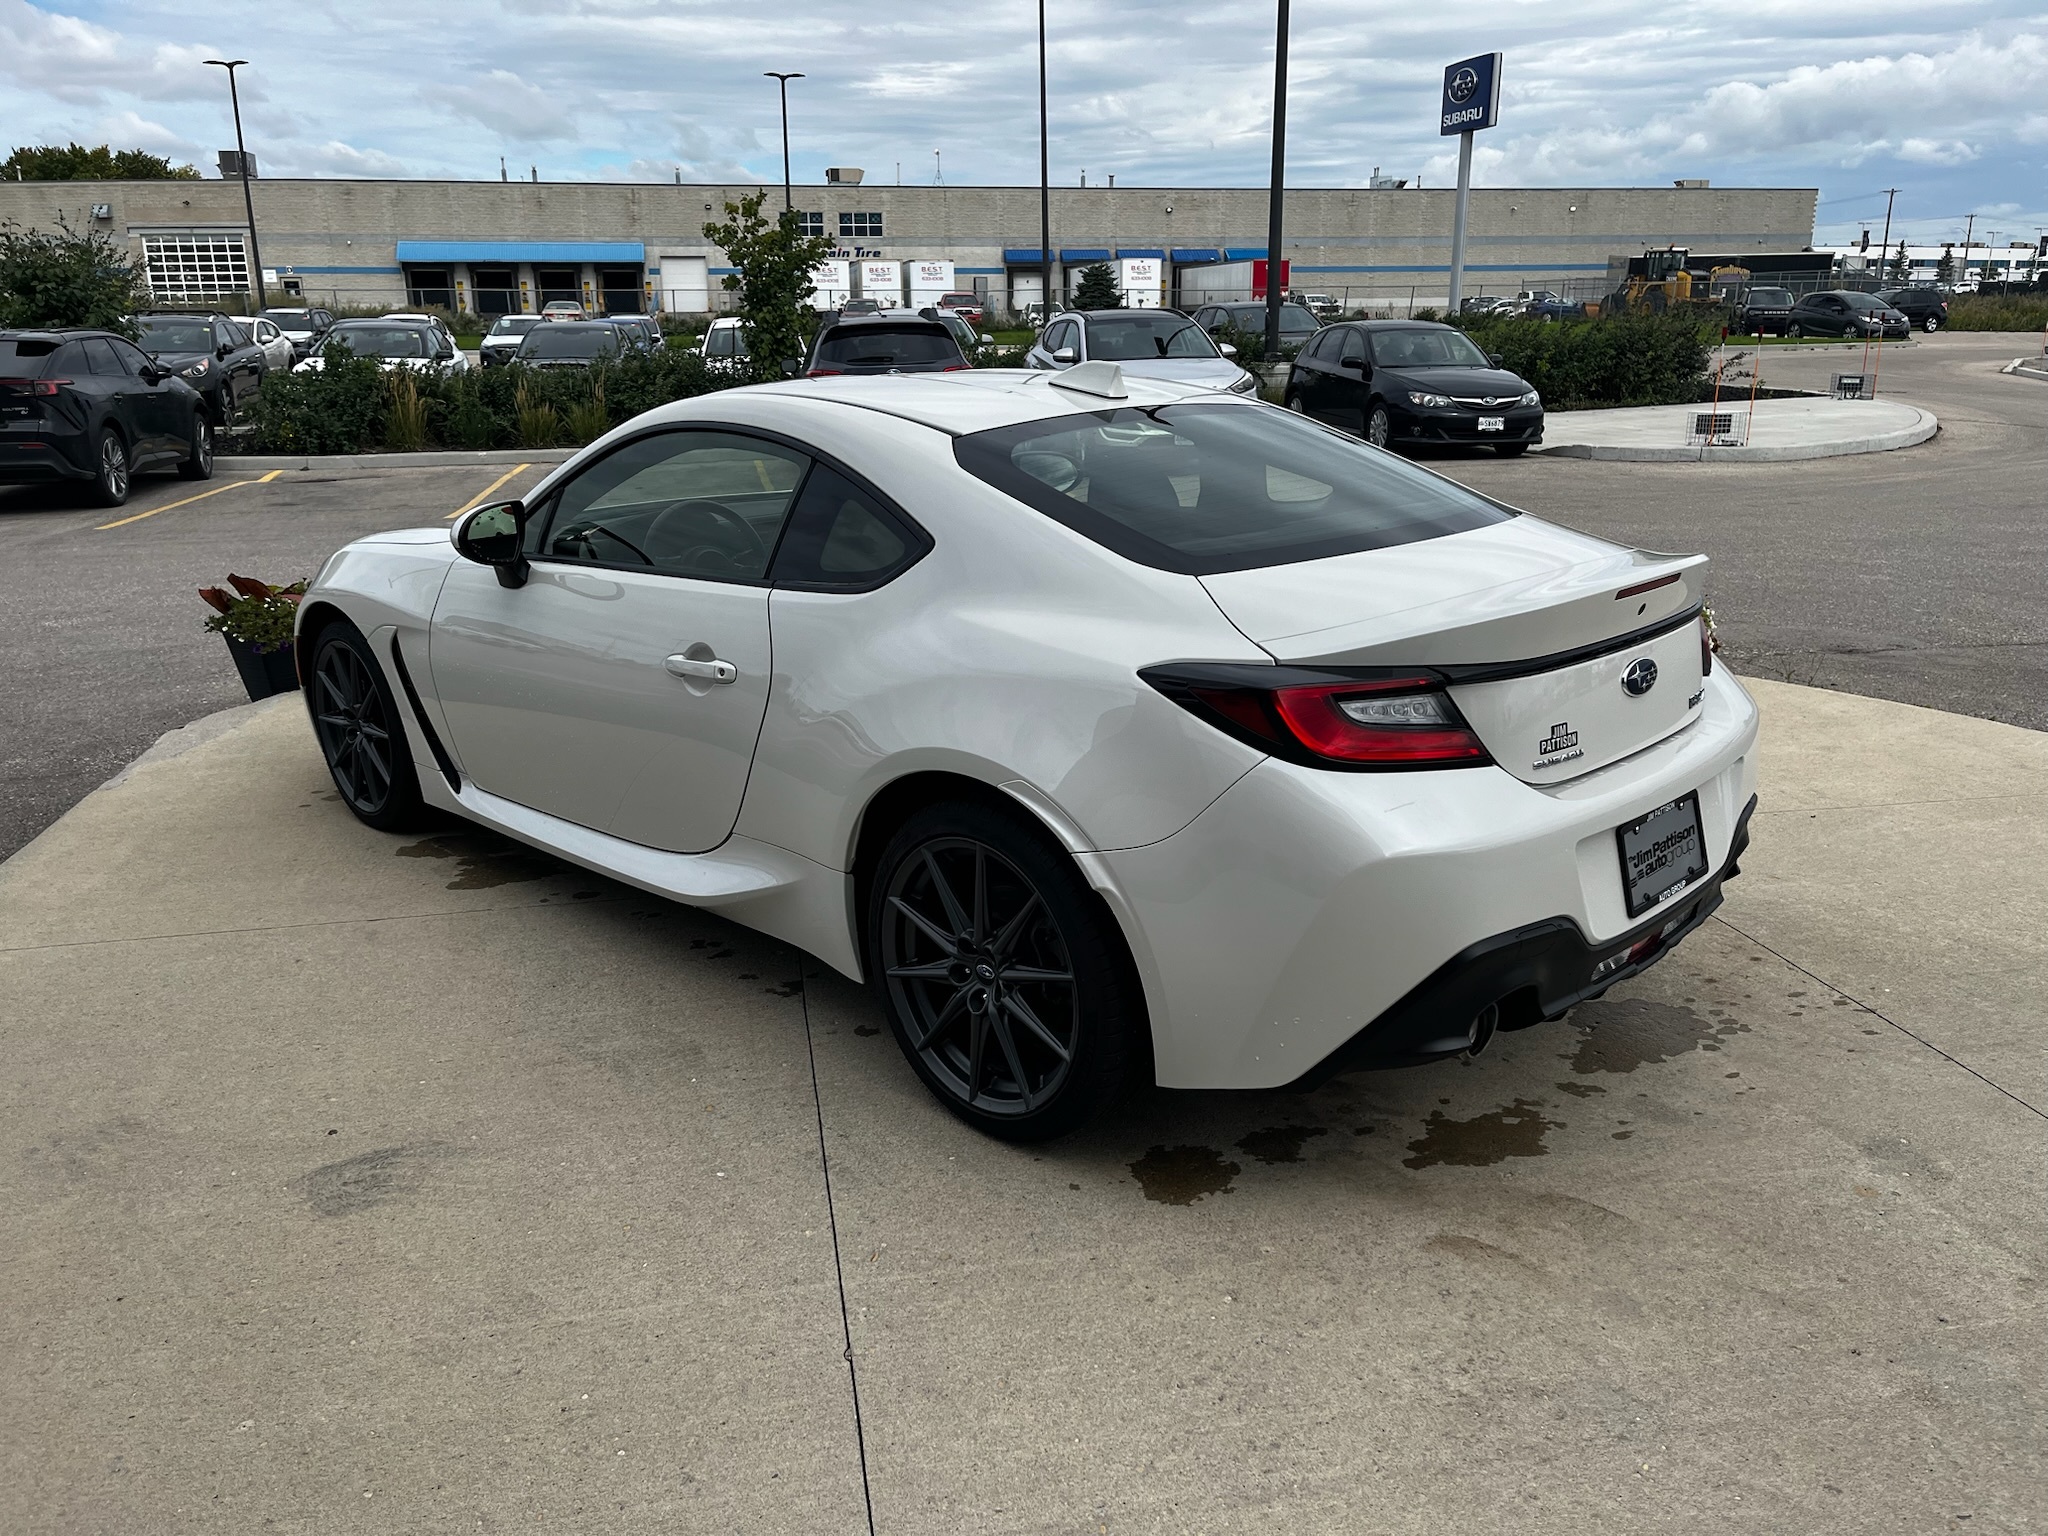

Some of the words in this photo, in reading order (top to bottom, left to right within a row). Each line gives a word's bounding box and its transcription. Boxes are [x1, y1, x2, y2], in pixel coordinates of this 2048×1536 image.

[1443, 107, 1483, 127] SUBARU
[854, 247, 881, 258] Tire
[1553, 724, 1567, 739] JIM
[1541, 732, 1577, 753] PATTISON
[1633, 847, 1653, 868] Jim
[1652, 824, 1696, 858] Pattison
[1659, 889, 1671, 902] AUTO
[1670, 879, 1687, 896] GROUP
